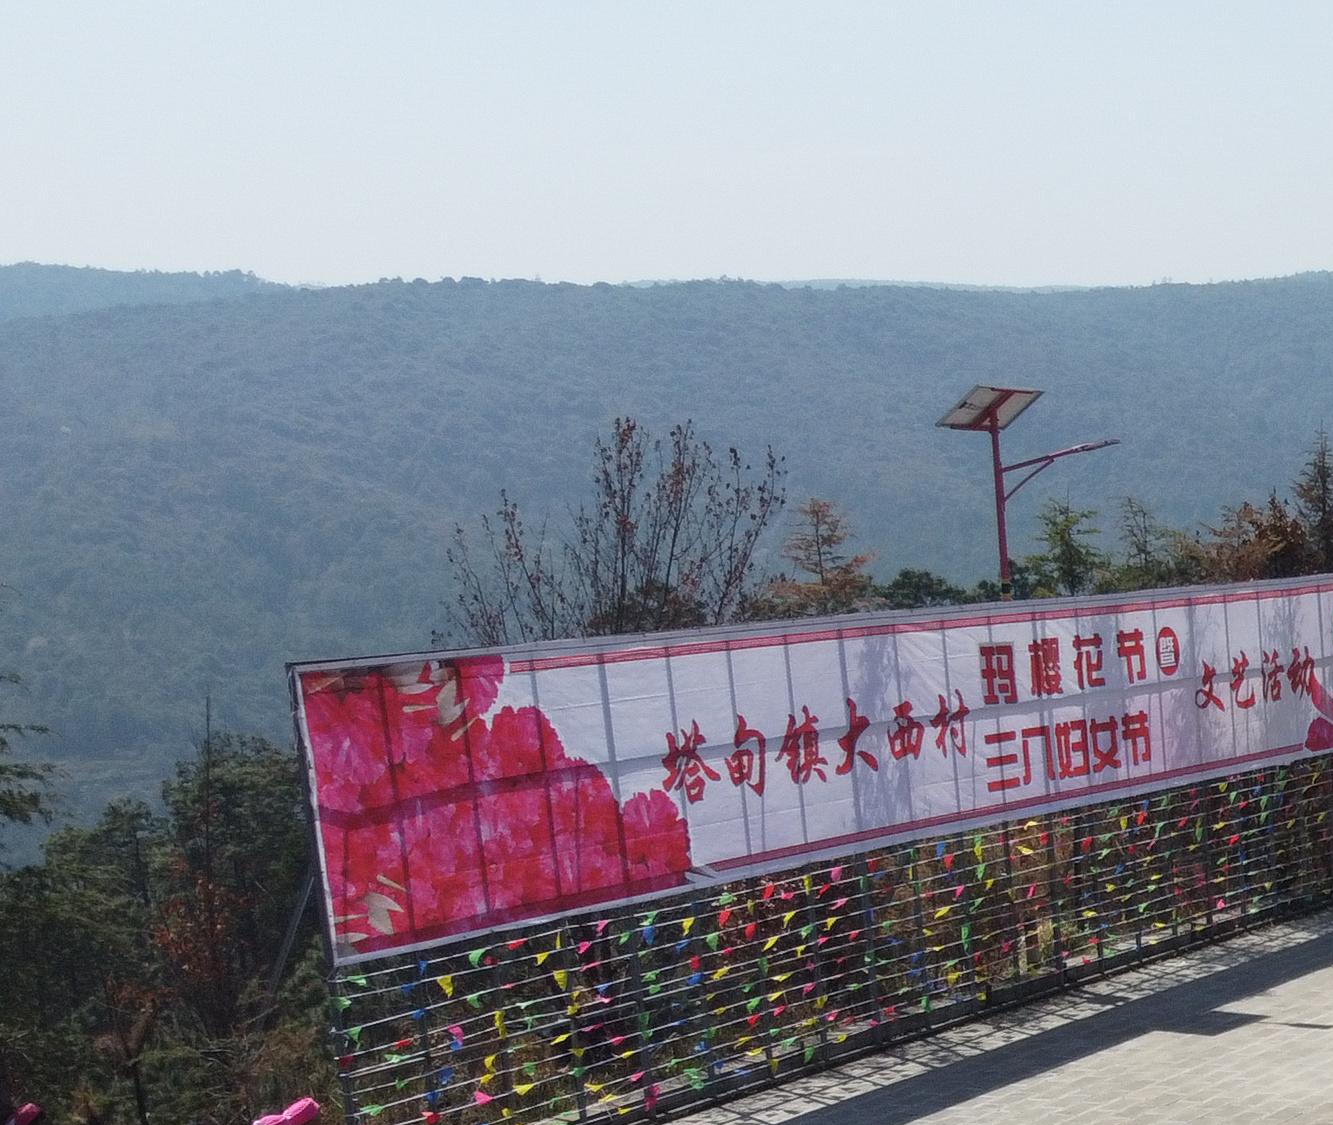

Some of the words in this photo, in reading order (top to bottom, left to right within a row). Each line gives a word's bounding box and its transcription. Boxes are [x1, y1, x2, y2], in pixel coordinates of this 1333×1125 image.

[1195, 645, 1315, 711] 文艺活动
[662, 689, 970, 804] 塔甸镇大西村
[985, 710, 1151, 792] 三八妇女节
